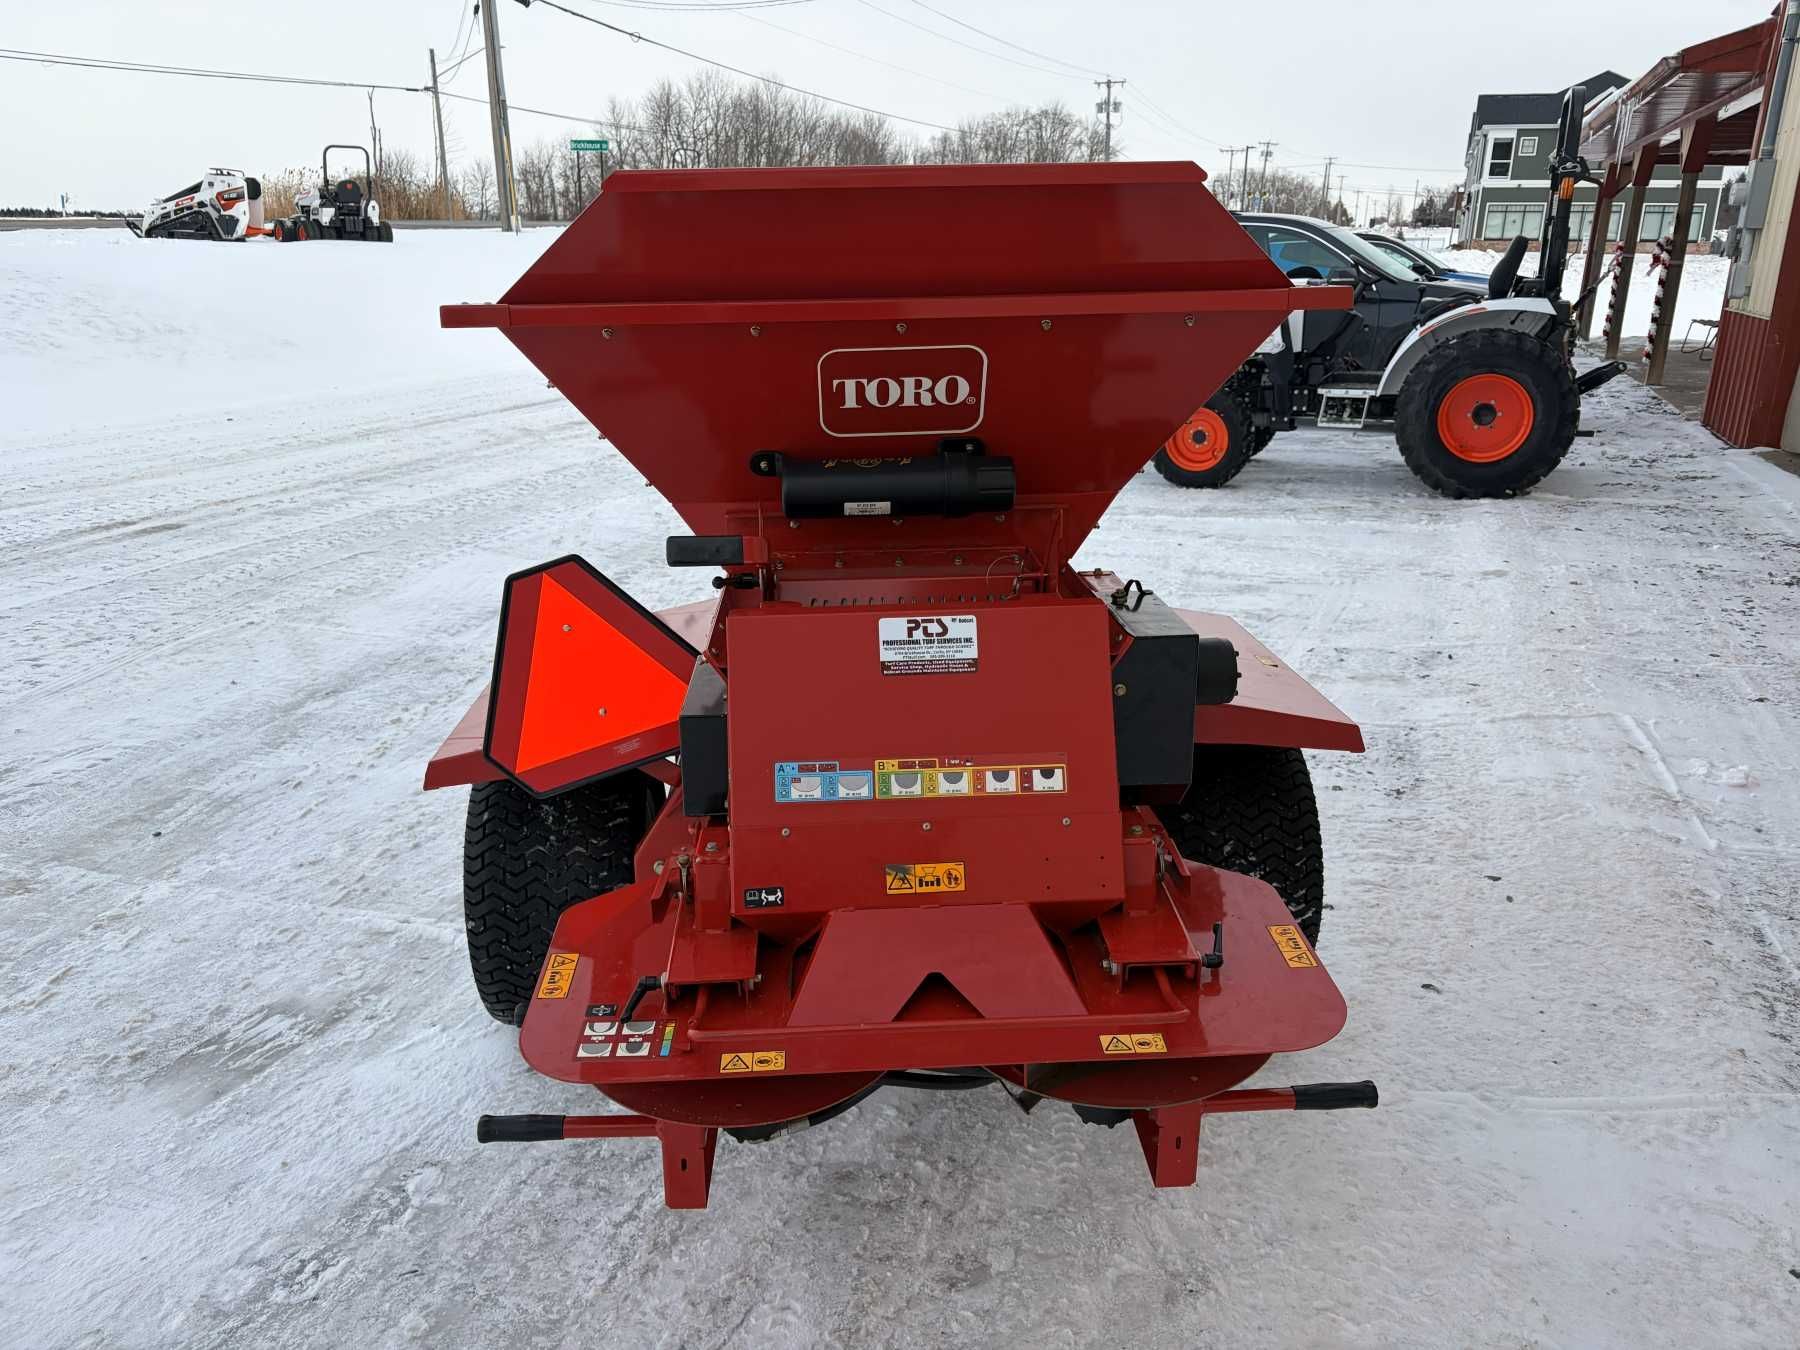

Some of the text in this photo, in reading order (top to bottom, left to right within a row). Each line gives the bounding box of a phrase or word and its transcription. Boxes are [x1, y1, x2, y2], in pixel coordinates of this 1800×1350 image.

[906, 618, 948, 638] PTS
[882, 638, 921, 646] PROFESSIONAL
[778, 764, 785, 773] A
[878, 762, 885, 770] B
